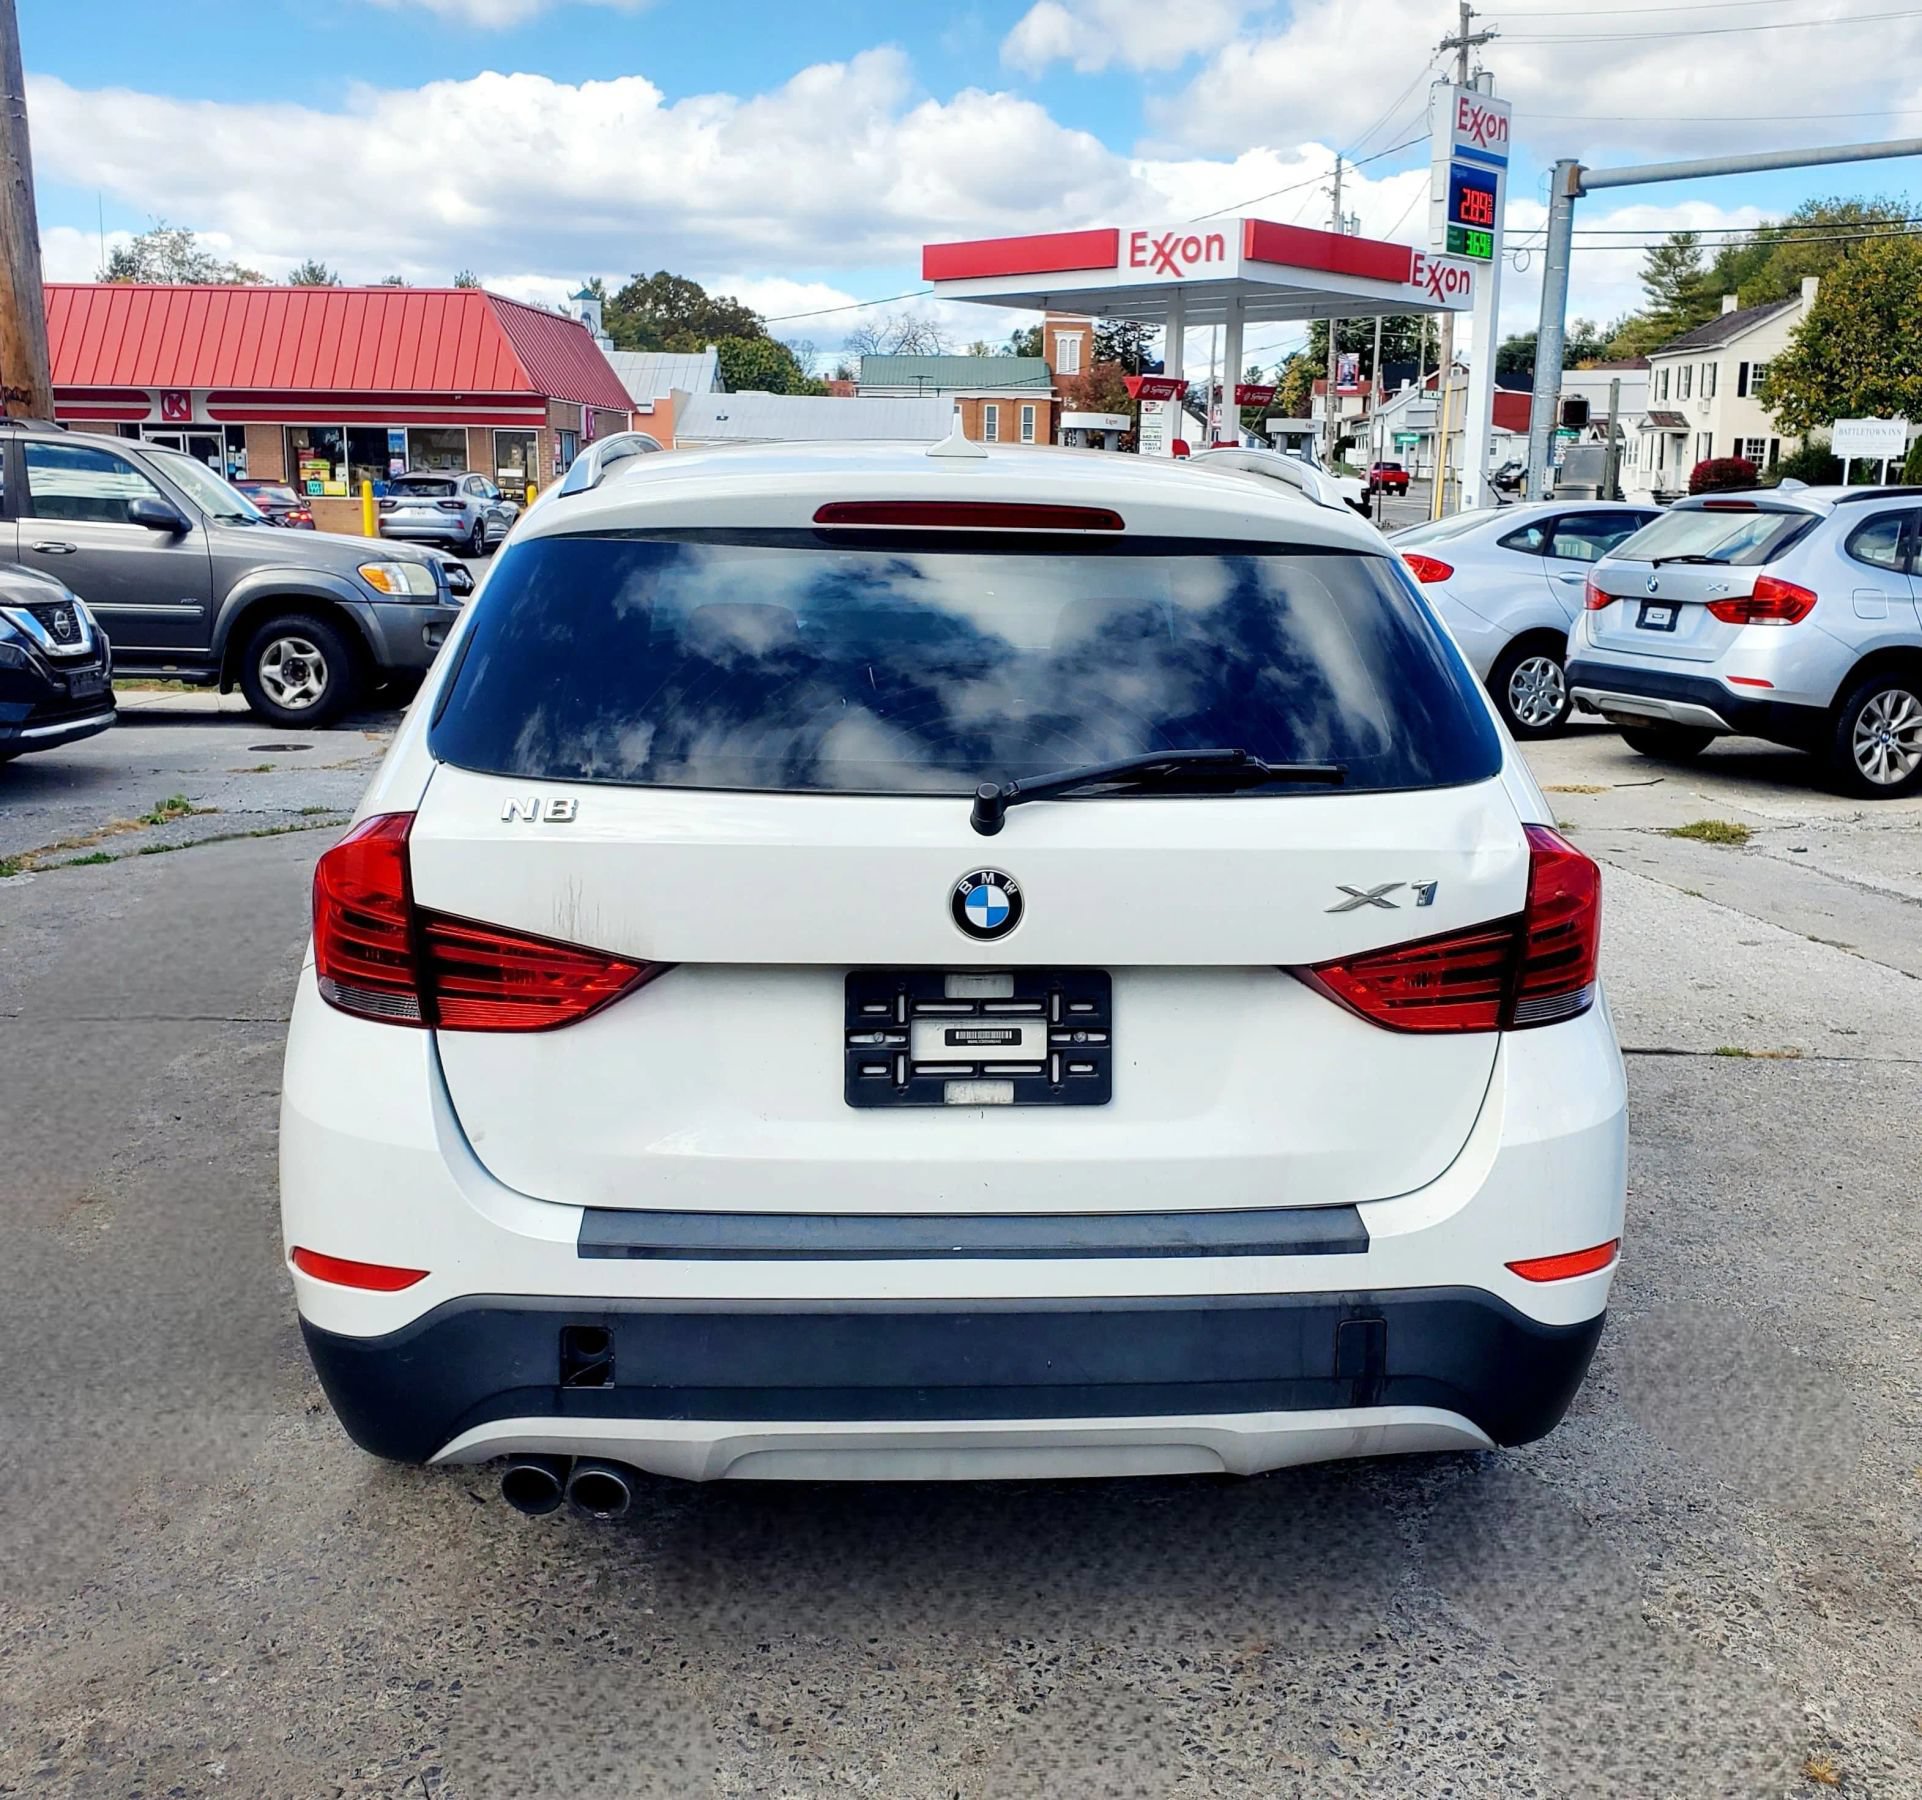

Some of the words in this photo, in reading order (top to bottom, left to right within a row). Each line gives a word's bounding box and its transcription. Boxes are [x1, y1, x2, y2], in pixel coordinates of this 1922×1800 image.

[1457, 96, 1508, 147] Exxon
[1129, 231, 1225, 277] Exxon
[1411, 253, 1470, 303] Exxon
[501, 797, 580, 824] NB
[959, 872, 1018, 896] BMW
[1323, 879, 1438, 913] X1
